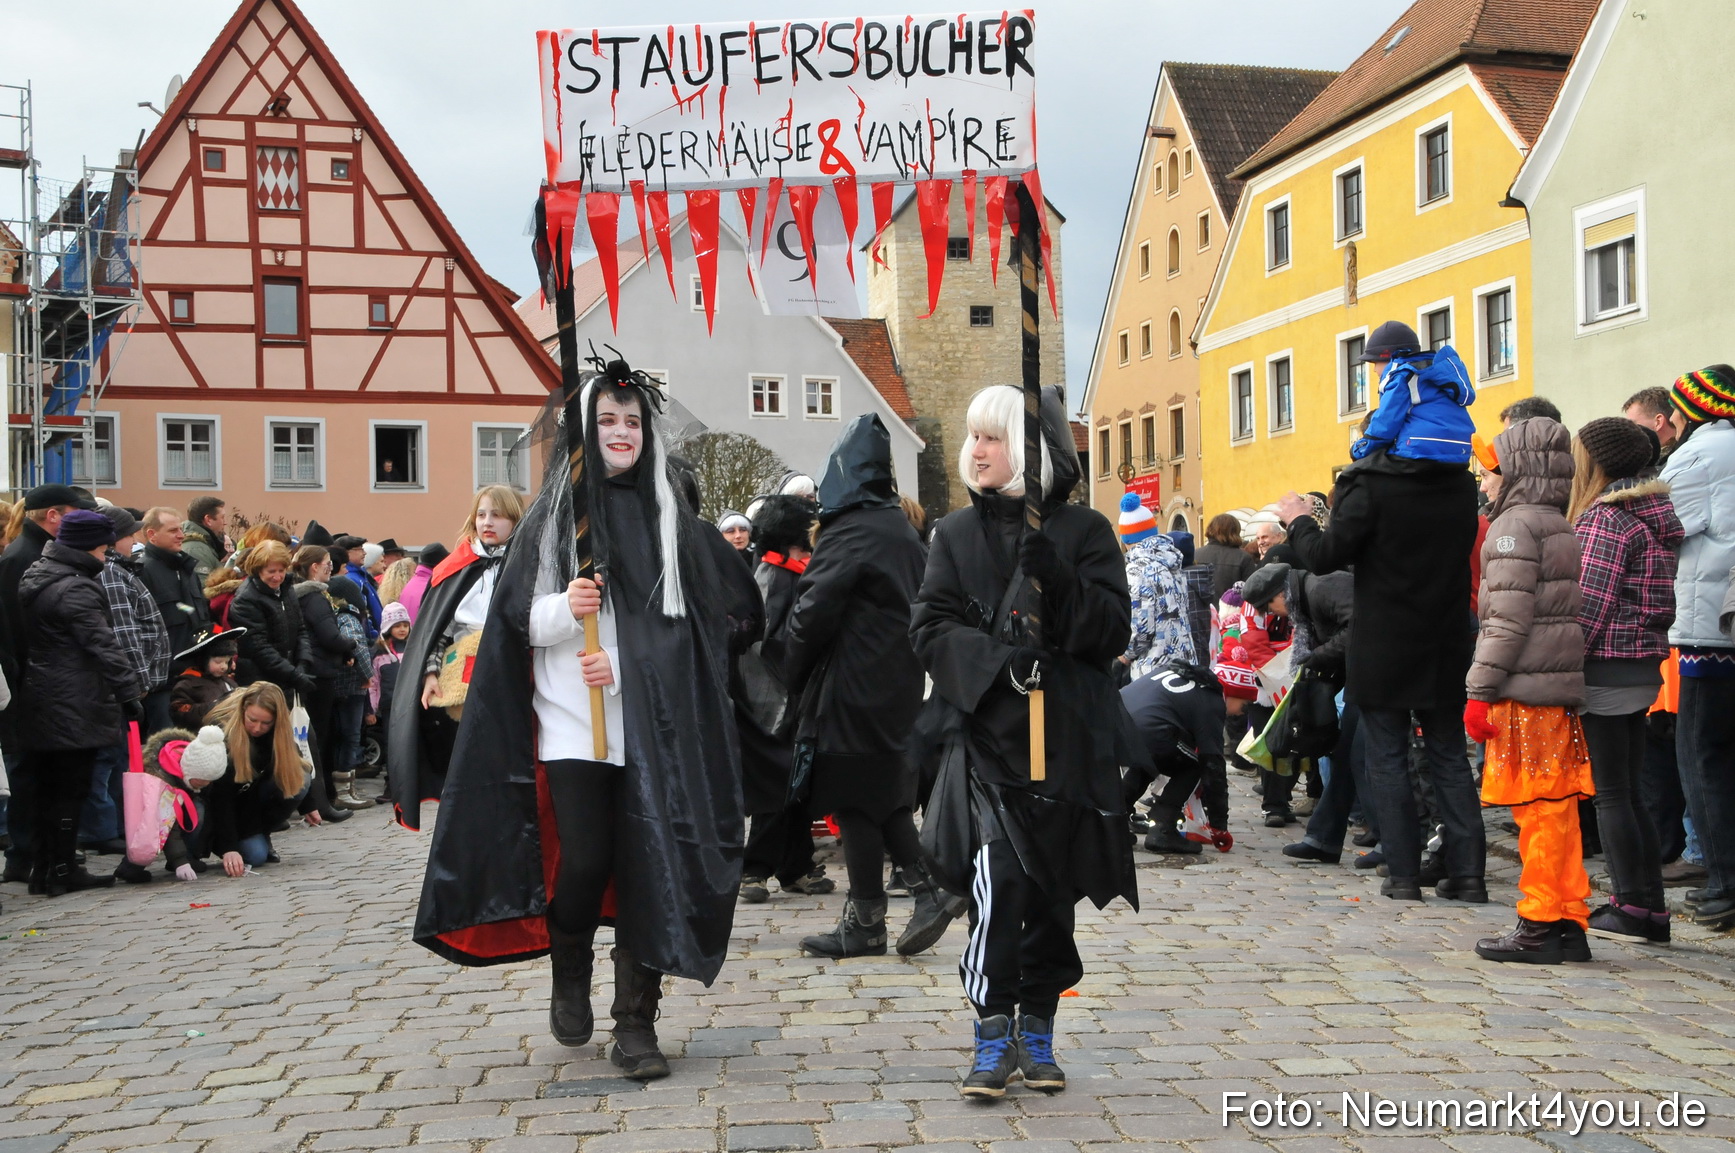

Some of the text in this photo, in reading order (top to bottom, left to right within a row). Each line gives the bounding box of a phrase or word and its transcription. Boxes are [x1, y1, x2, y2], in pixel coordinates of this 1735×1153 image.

[566, 17, 1034, 93] STAUFERSBUCHER
[818, 119, 856, 176] &
[855, 109, 1017, 180] VAMPIRE
[776, 220, 817, 282] 9
